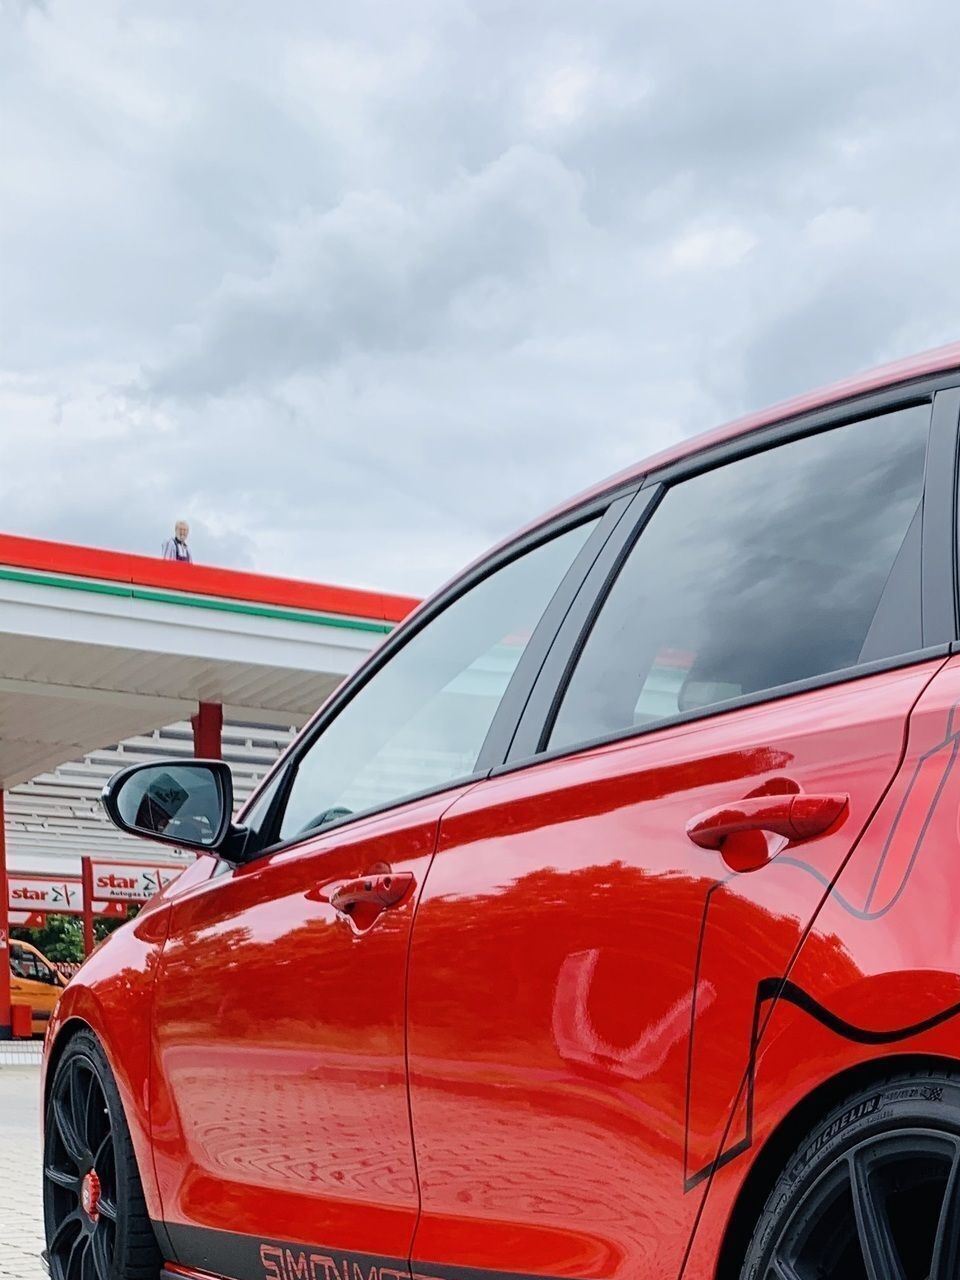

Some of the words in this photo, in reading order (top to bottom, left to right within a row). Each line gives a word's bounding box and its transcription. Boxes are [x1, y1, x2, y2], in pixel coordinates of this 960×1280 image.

[97, 874, 138, 889] star
[11, 887, 48, 901] star
[805, 1098, 876, 1162] MICHELIN
